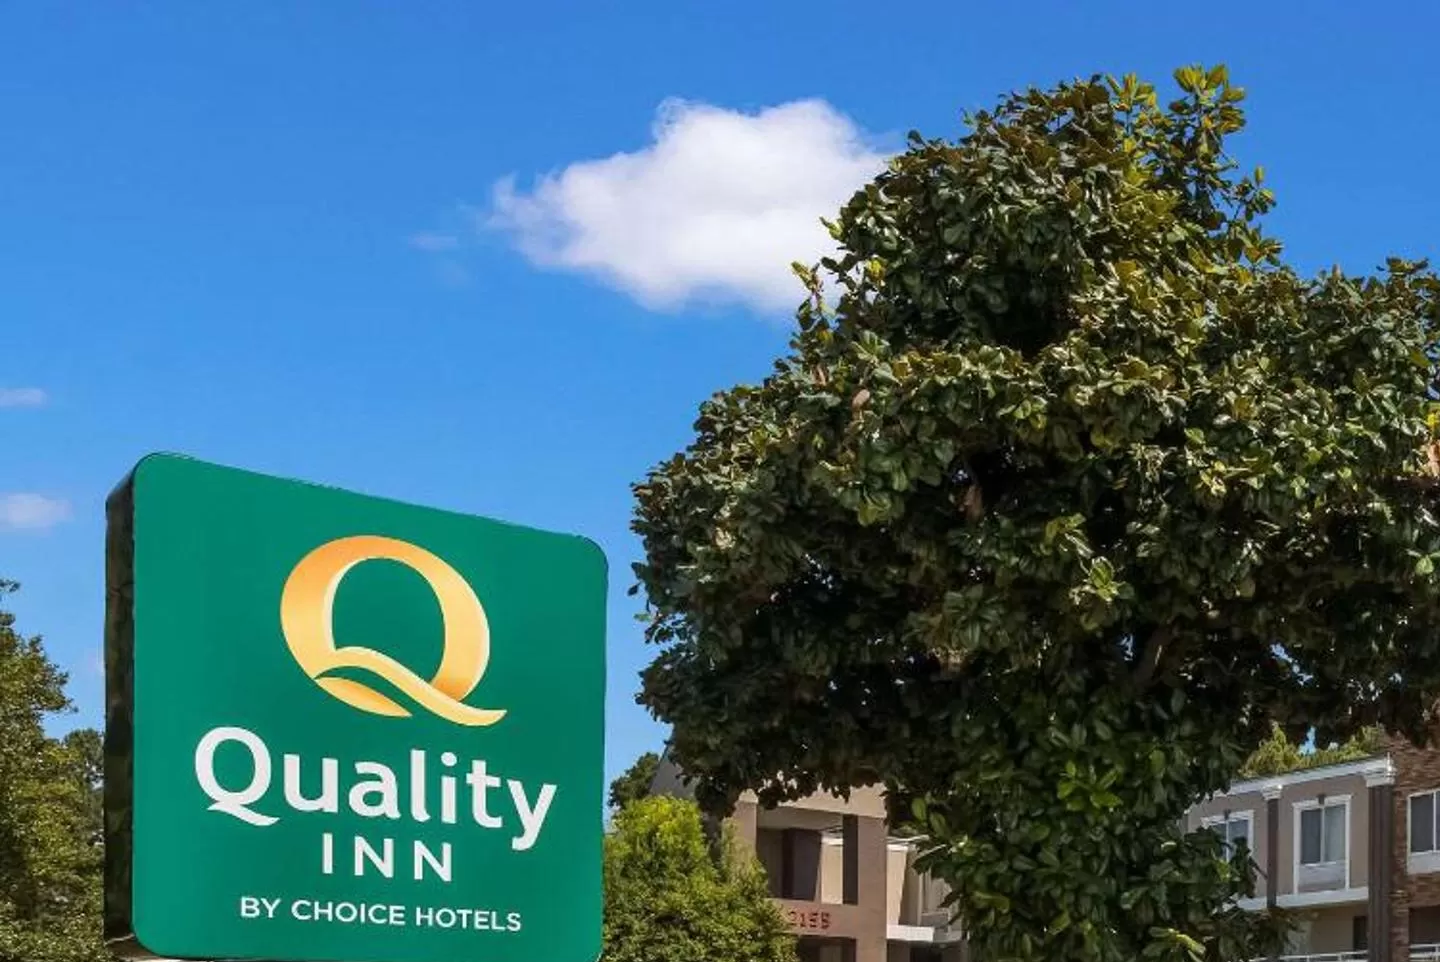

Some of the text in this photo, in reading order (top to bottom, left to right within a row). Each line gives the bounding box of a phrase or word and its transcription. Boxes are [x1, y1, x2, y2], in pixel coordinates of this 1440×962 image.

[280, 535, 507, 726] Q
[195, 726, 557, 850] Quality
[322, 833, 452, 882] INN
[240, 897, 522, 932] BY CHOICE HOTELS
